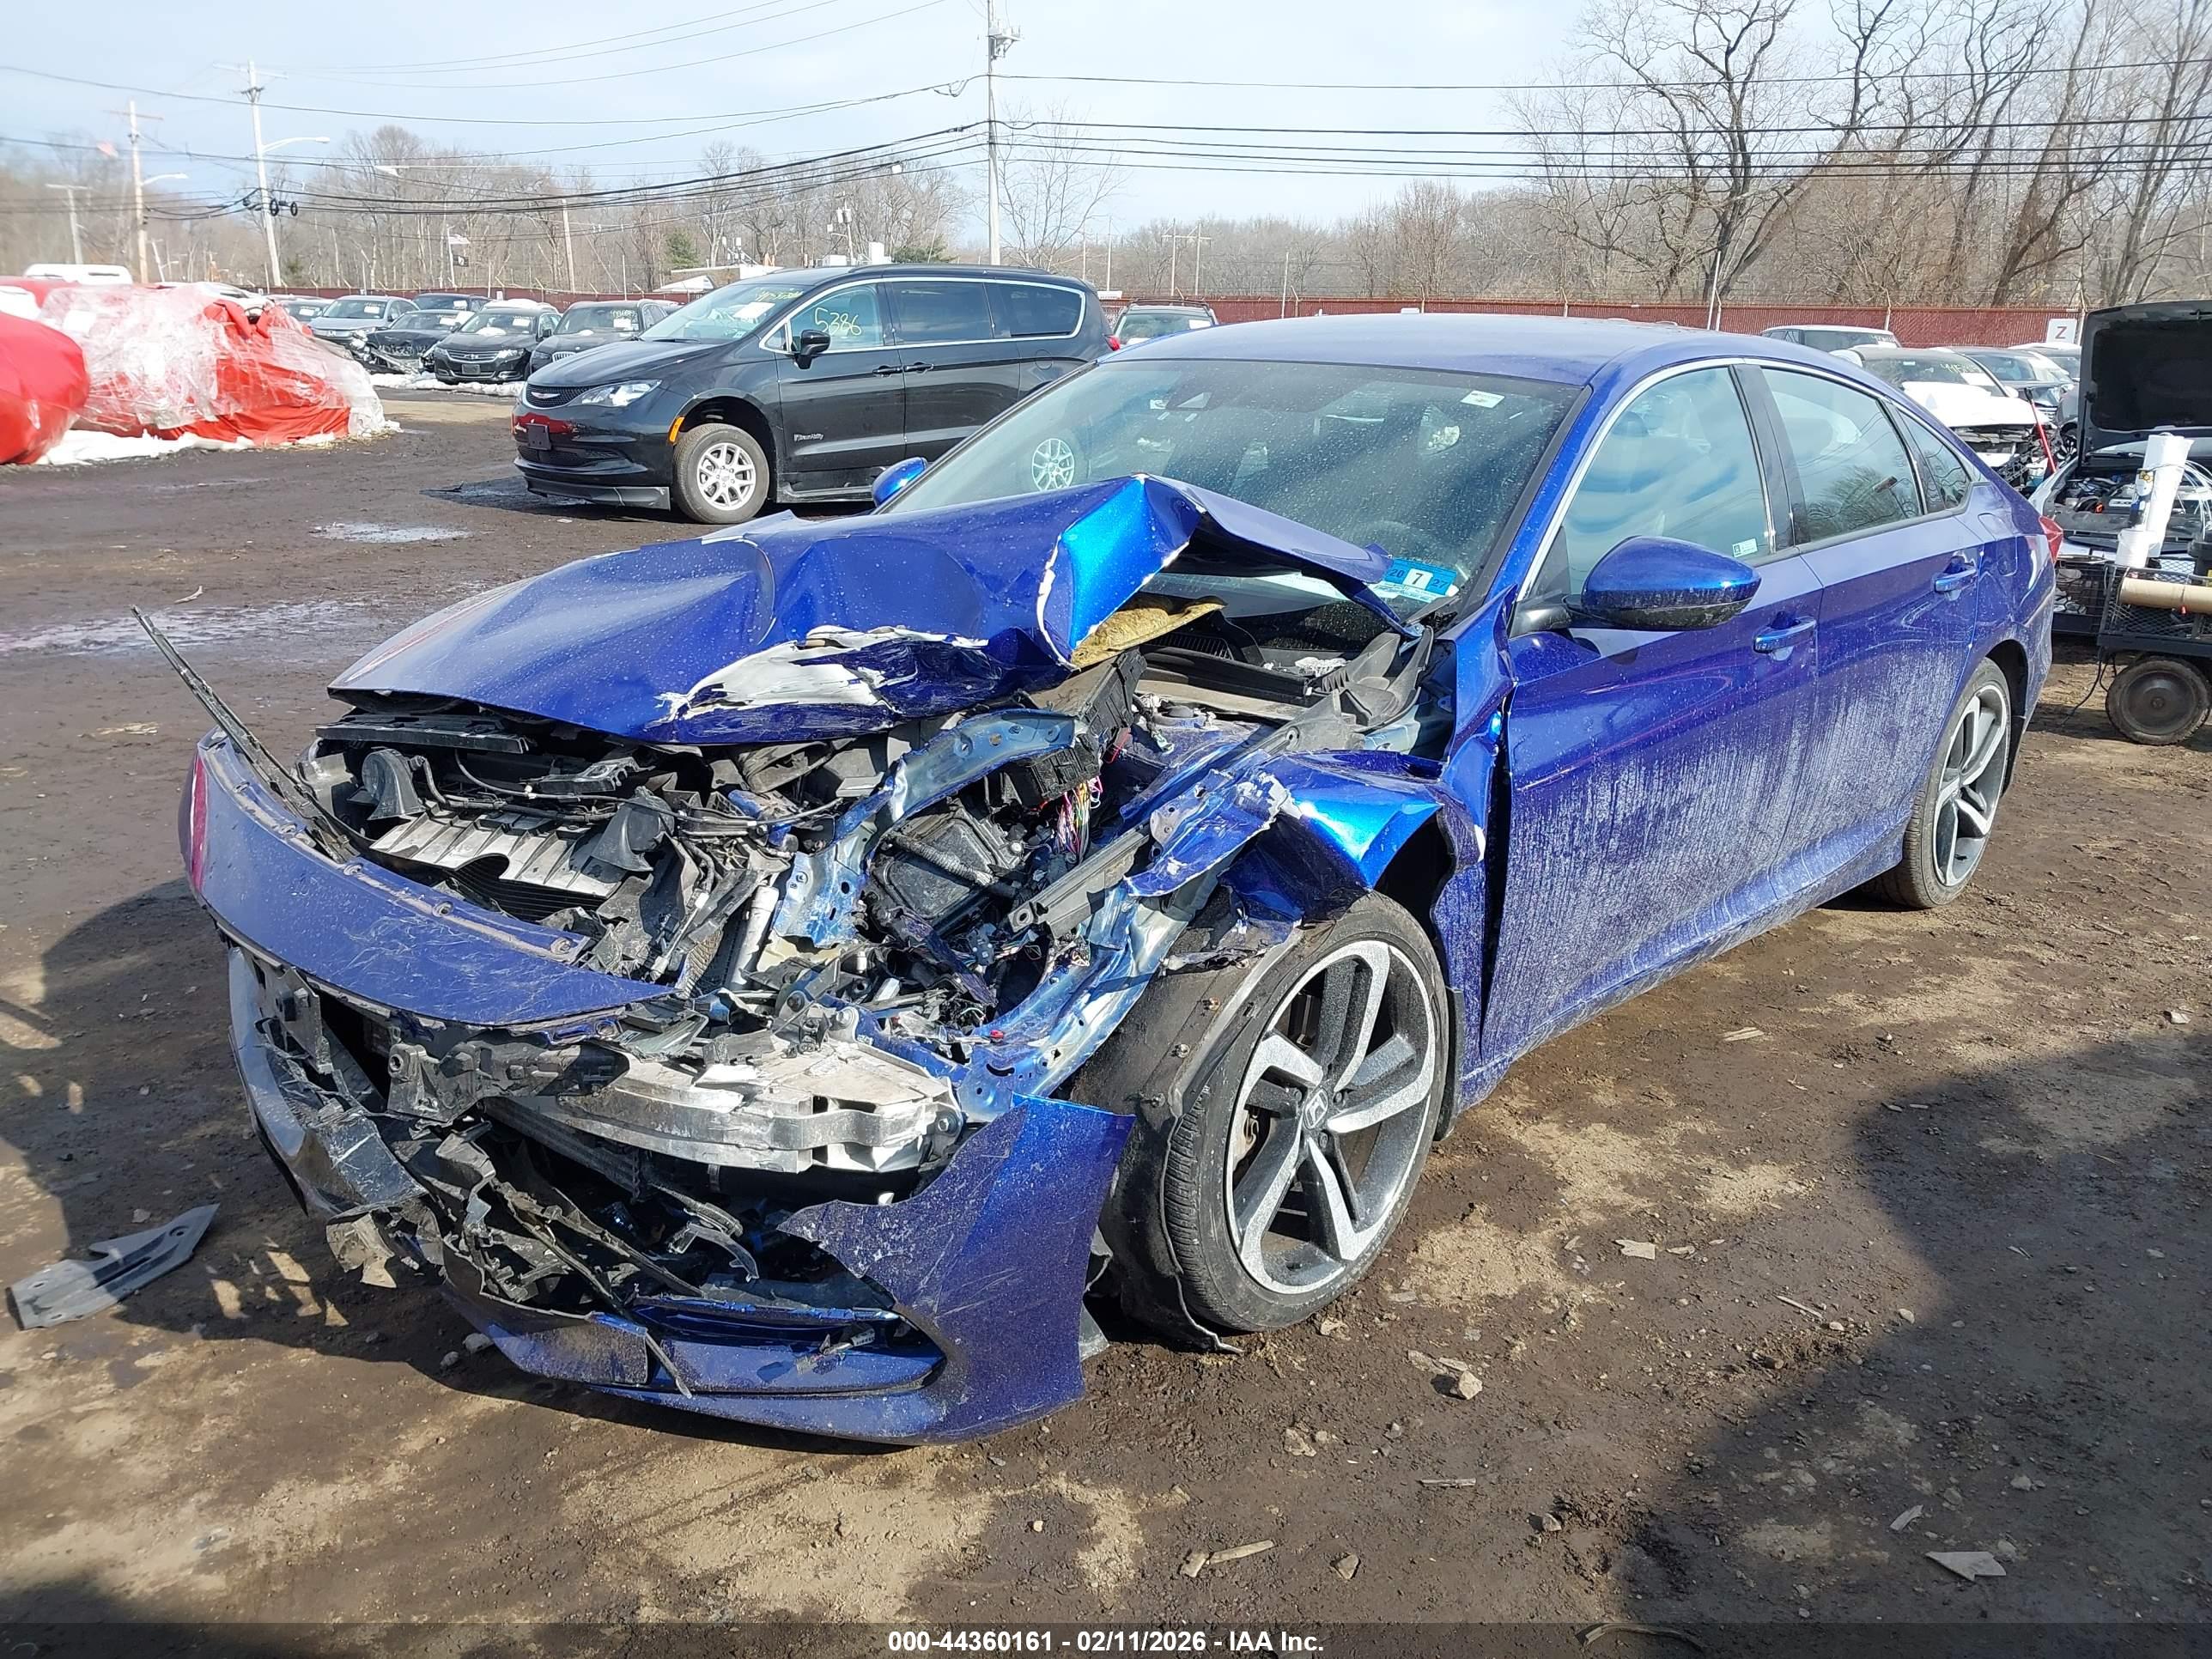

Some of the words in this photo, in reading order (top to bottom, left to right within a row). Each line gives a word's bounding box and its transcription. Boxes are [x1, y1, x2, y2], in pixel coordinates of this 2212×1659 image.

[815, 307, 862, 336] 5386
[2055, 325, 2068, 339] Z
[1390, 568, 1405, 578] 20
[1412, 572, 1424, 585] 7
[1431, 578, 1449, 589] 27
